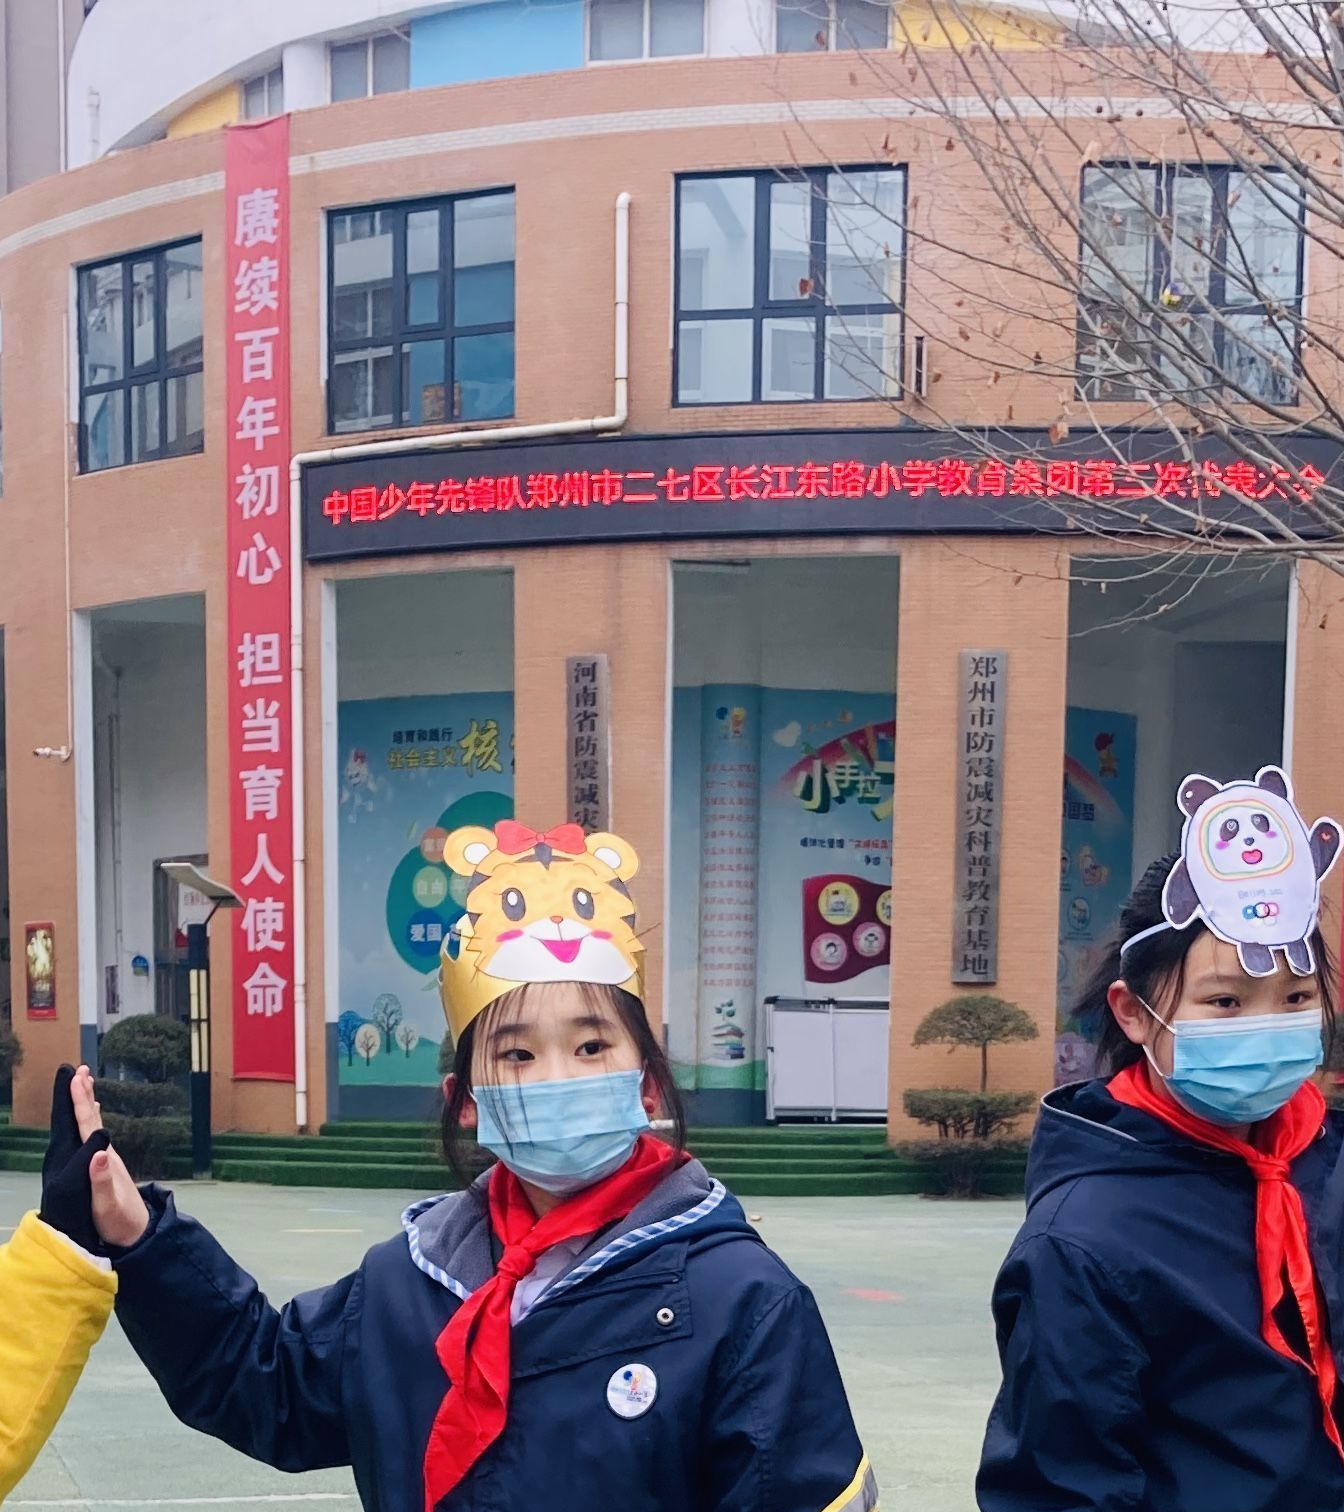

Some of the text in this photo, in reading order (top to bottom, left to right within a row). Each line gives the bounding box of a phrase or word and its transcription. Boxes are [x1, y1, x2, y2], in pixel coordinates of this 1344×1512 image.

[234, 187, 288, 1018] 赓续百年初心 担当育人使命
[574, 661, 599, 836] 河南省防震减灾
[959, 655, 998, 976] 郑州市防震减灾科普教育基地
[410, 922, 442, 943] 爱国
